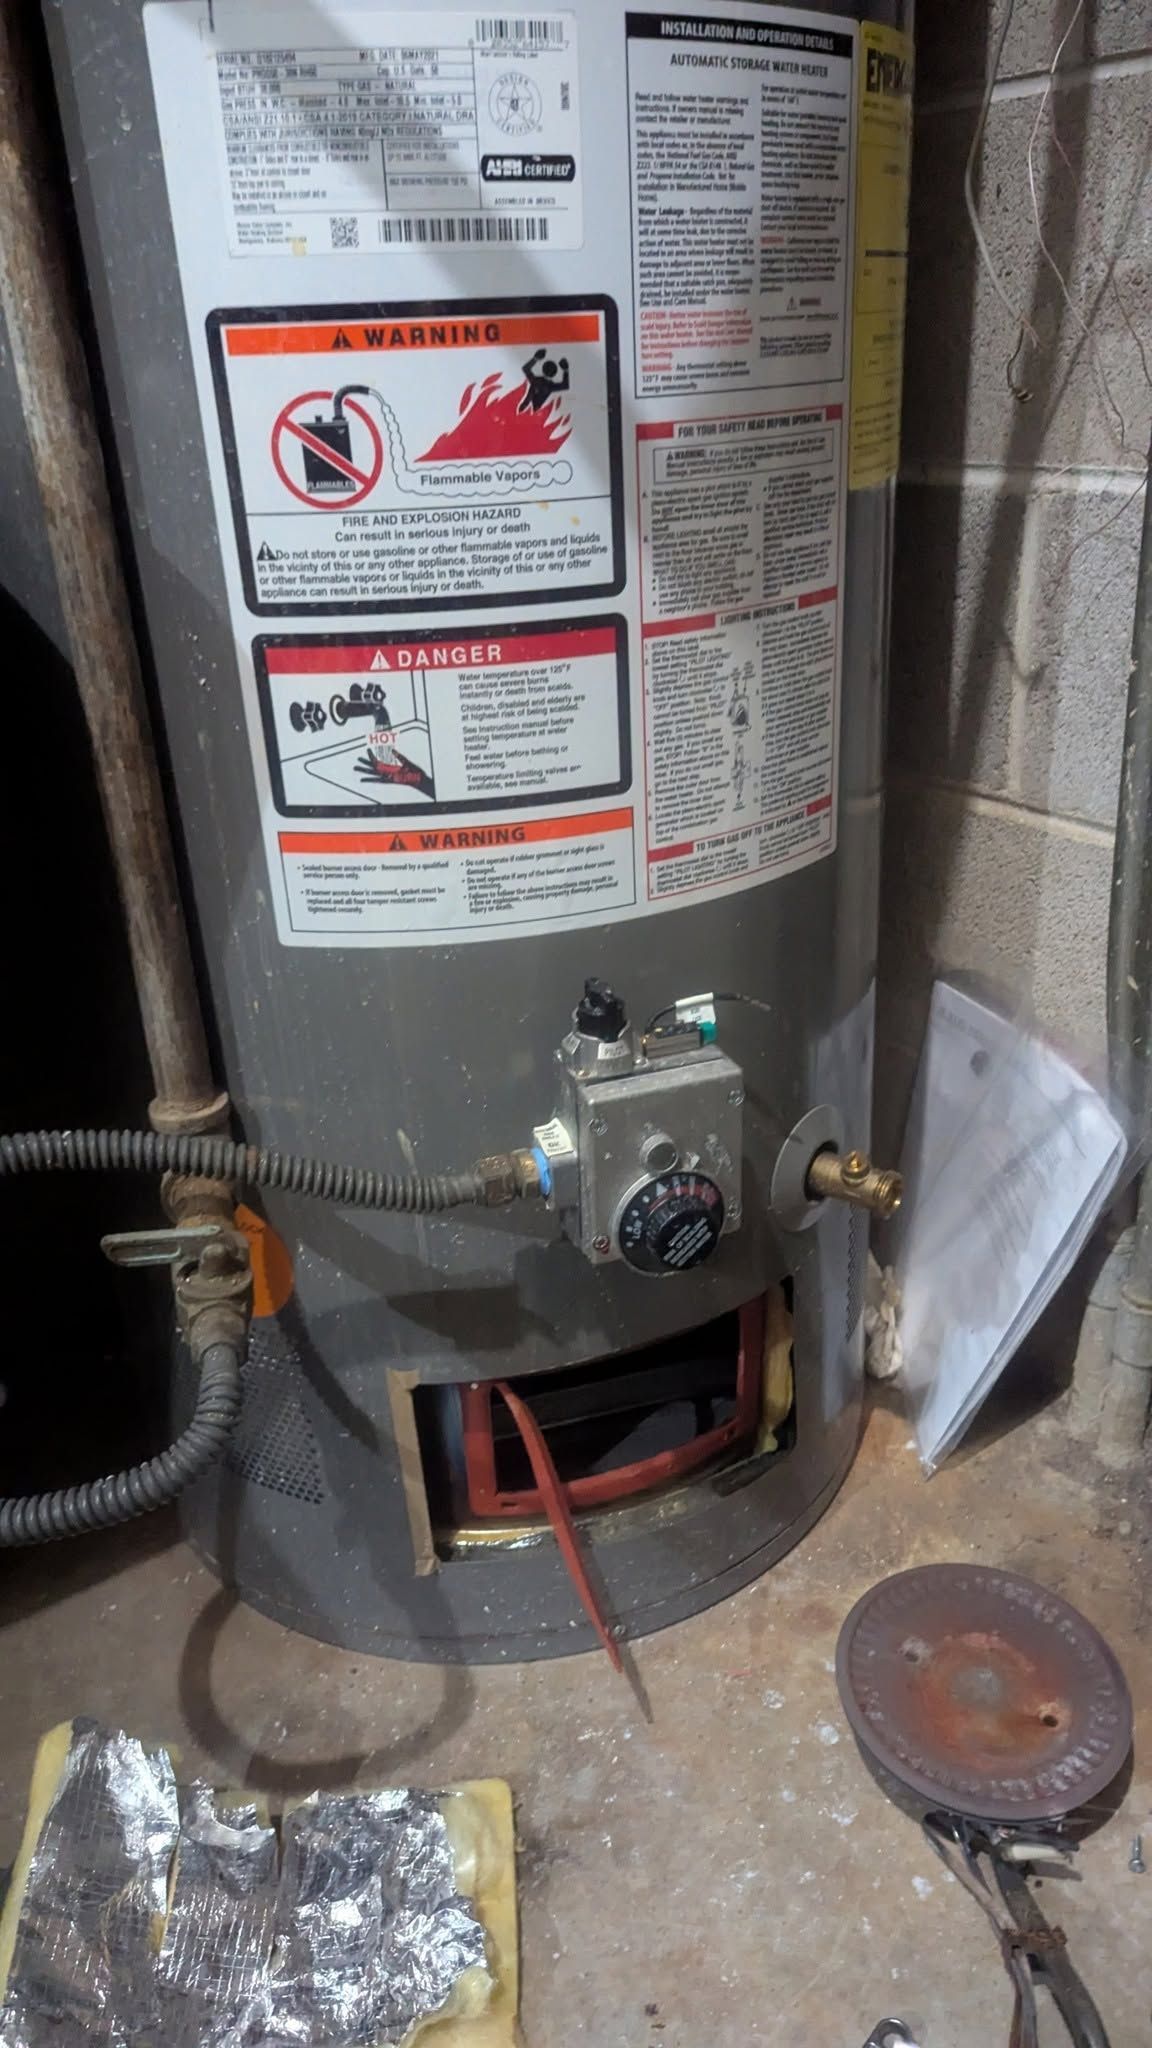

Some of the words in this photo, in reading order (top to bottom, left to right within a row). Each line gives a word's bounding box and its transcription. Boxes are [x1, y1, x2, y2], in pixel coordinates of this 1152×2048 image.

[661, 22, 734, 38] INSTALLATION
[735, 26, 756, 40] AND
[757, 29, 803, 45] OPERATION
[805, 34, 834, 50] DETAILS
[670, 54, 728, 68] AUTOMATIC
[731, 56, 770, 71] STORAGE
[772, 60, 800, 74] WATER
[802, 63, 828, 78] HEATER
[363, 323, 500, 347] WARNING
[678, 426, 693, 437] FOR
[697, 424, 716, 435] YOUR
[719, 421, 745, 433] SAFETY
[747, 419, 765, 431] READ
[420, 473, 492, 486] Flammable
[496, 470, 541, 483] Vapors
[342, 516, 369, 526] FIRE
[372, 515, 398, 525] AND
[401, 512, 470, 524] EXPLOSION
[473, 508, 521, 520] HAZARD
[335, 532, 356, 542] Can
[360, 531, 391, 541] result
[394, 530, 405, 539] in
[408, 528, 449, 538] serious
[452, 526, 483, 538] injury
[487, 526, 498, 534] or
[501, 522, 531, 533] death
[276, 551, 290, 560] Do
[293, 551, 308, 559] not
[311, 550, 337, 559] store
[373, 547, 416, 558] gasoline
[432, 544, 457, 553] other
[461, 541, 512, 551] flammable
[515, 539, 547, 550] vapors
[550, 536, 567, 545] and
[570, 534, 600, 546] liquids
[268, 563, 284, 572] the
[321, 562, 331, 571] of
[333, 562, 352, 570] this
[369, 562, 386, 571] any
[389, 559, 415, 568] other
[418, 556, 469, 569] appliance.
[471, 554, 509, 566] Storage
[512, 552, 521, 561] of
[537, 551, 554, 559] use
[557, 548, 567, 557] of
[569, 545, 607, 558] gasoline
[271, 576, 296, 584] other
[300, 574, 350, 584] flammable
[352, 574, 386, 584] vapors
[389, 573, 399, 581] or
[402, 571, 434, 582] liquids
[437, 570, 446, 578] in
[449, 569, 464, 578] the
[467, 566, 501, 578] vicinity
[503, 565, 513, 574] of
[515, 564, 533, 573] this
[548, 562, 564, 572] any
[567, 559, 590, 568] other
[261, 588, 307, 599] appliance
[330, 586, 358, 595] result
[360, 586, 369, 594] in
[372, 584, 408, 594] serious
[410, 583, 438, 594] injury
[440, 583, 451, 591] or
[453, 580, 484, 589] death.
[720, 612, 751, 625] LIGHTING
[753, 603, 795, 618] INSTRUCTIONS
[398, 645, 502, 667] DANGER
[458, 673, 480, 681] Water
[483, 670, 529, 681] temperature
[527, 676, 549, 685] burns
[505, 687, 526, 696] death
[528, 685, 546, 693] from
[497, 700, 529, 709] disabled
[531, 698, 545, 706] and
[547, 696, 571, 706] elderly
[470, 712, 499, 722] highest
[501, 710, 515, 718] risk
[517, 709, 525, 717] of
[526, 707, 547, 717] being
[463, 726, 477, 734] See
[521, 720, 548, 729] manual
[550, 717, 574, 726] before
[369, 732, 397, 744] HOT
[463, 734, 489, 745] setting
[491, 730, 536, 742] temperature
[547, 726, 567, 735] water
[483, 752, 503, 760] water
[505, 749, 529, 758] before
[531, 746, 559, 757] bathing
[467, 772, 514, 784] Temperature
[420, 826, 526, 849] WARNING
[697, 842, 705, 853] TO
[708, 837, 725, 850] TURN
[727, 833, 739, 845] GAS
[741, 829, 752, 840] OFF
[776, 811, 804, 828] APPLIANCE
